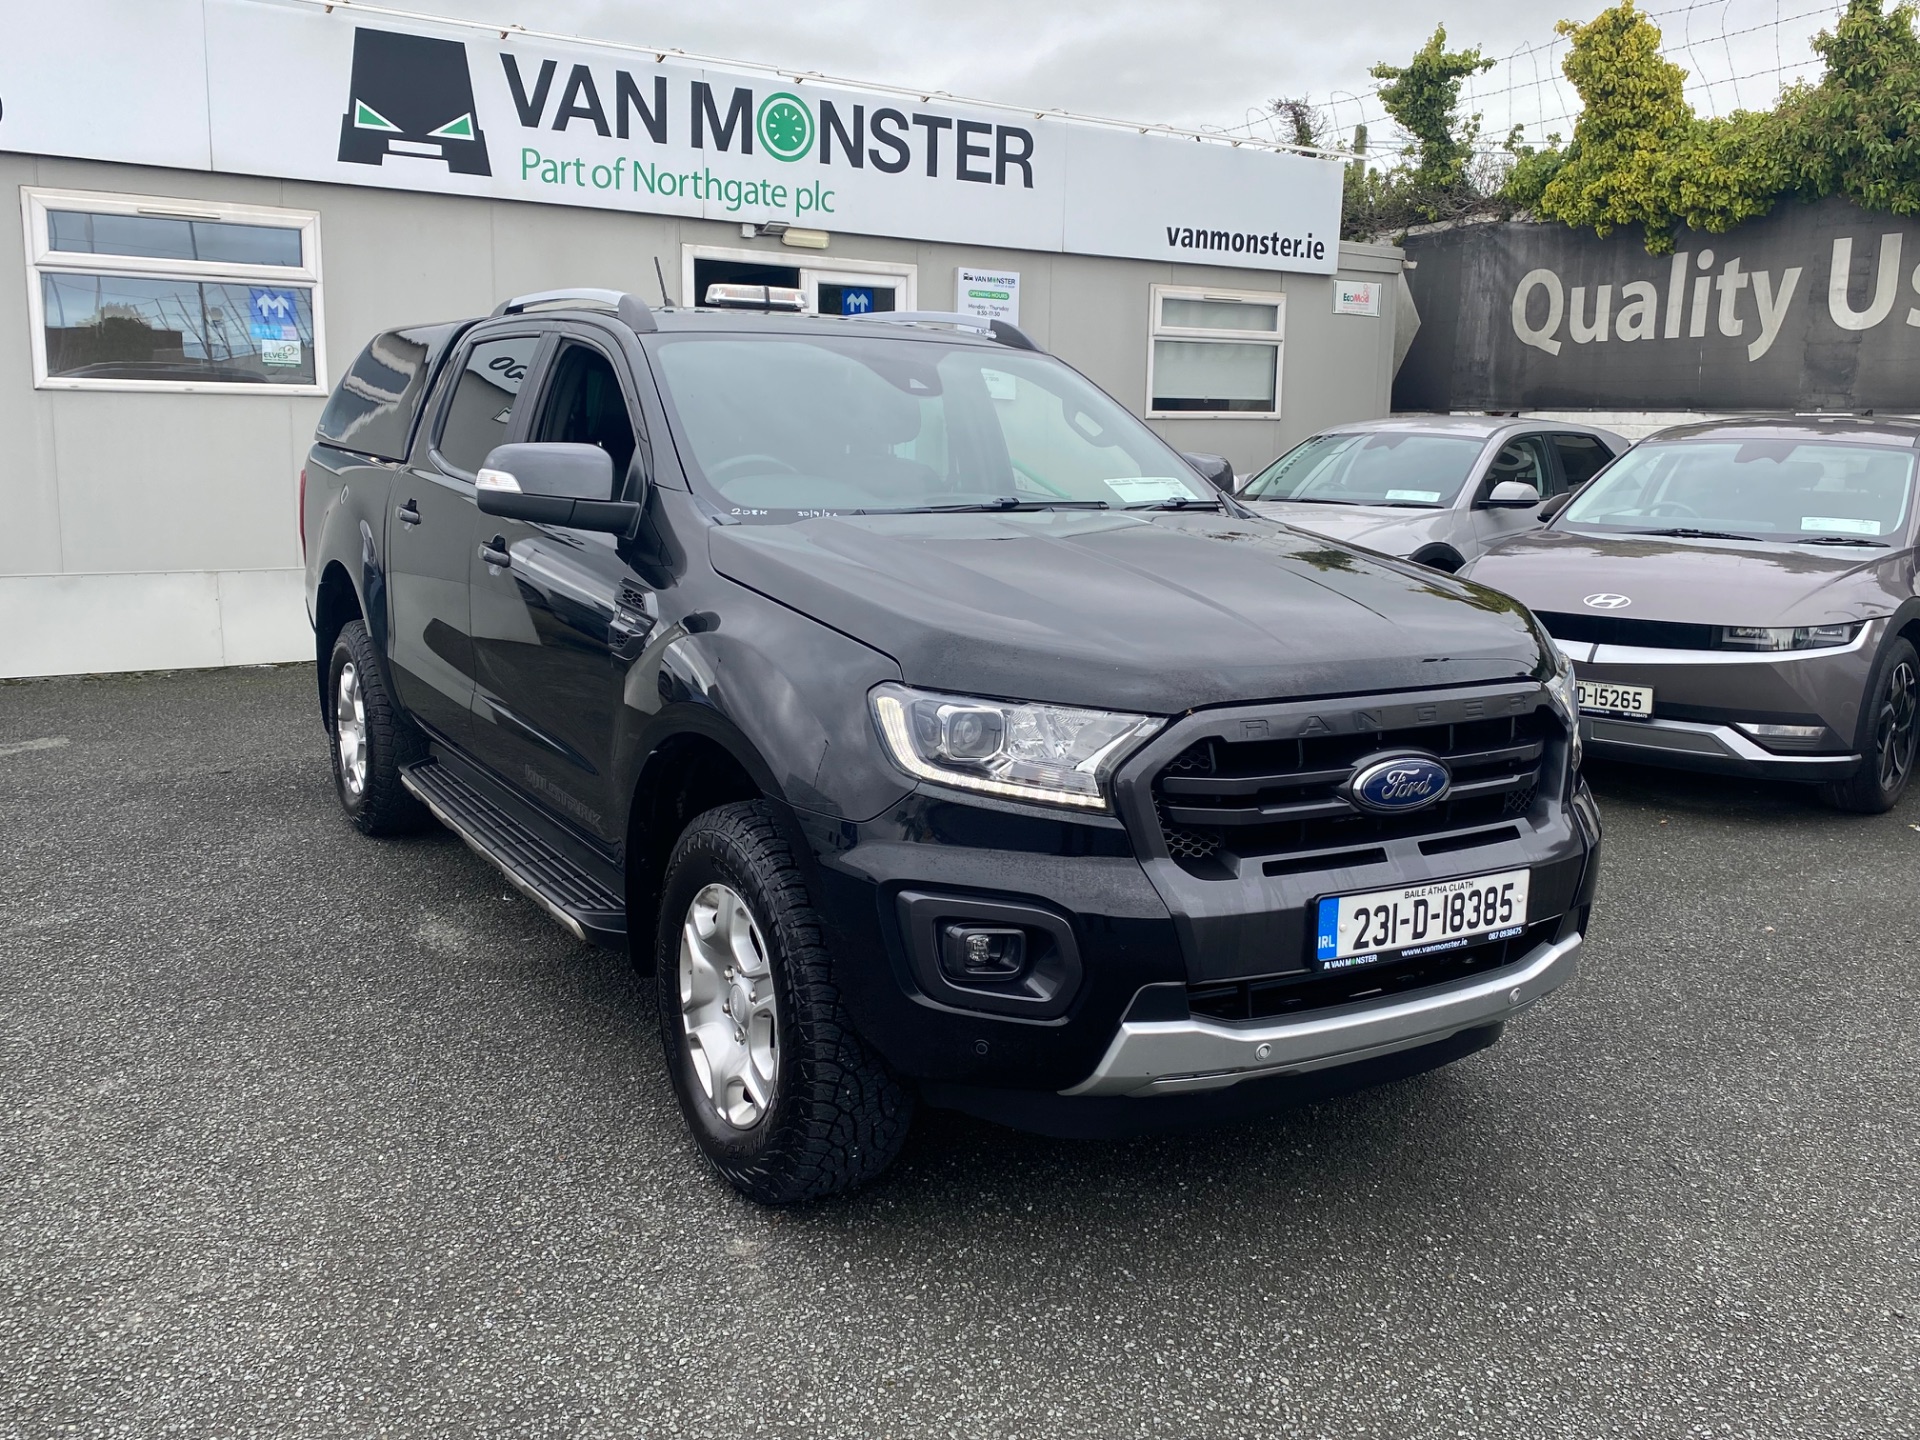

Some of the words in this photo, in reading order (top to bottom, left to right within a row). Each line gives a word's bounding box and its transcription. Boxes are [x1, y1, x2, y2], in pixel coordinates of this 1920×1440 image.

[499, 52, 667, 145] VAN
[690, 80, 1034, 189] MONSTER
[521, 148, 585, 187] Part
[591, 156, 625, 190] of
[633, 161, 787, 212] Northgate
[795, 180, 835, 217] plc
[1166, 226, 1325, 260] vanmonster.ie
[1511, 249, 1803, 362] Quality
[1577, 686, 1642, 710] D-15265
[1239, 695, 1528, 738] RANGER
[1381, 768, 1433, 800] Ford
[1405, 889, 1426, 899] BAILE
[1449, 881, 1474, 891] CLIATH
[1353, 883, 1514, 950] 231-D-18385
[1318, 935, 1335, 949] IRL
[1401, 938, 1468, 957] www.vanmonster.ie
[1331, 960, 1345, 968] VAN
